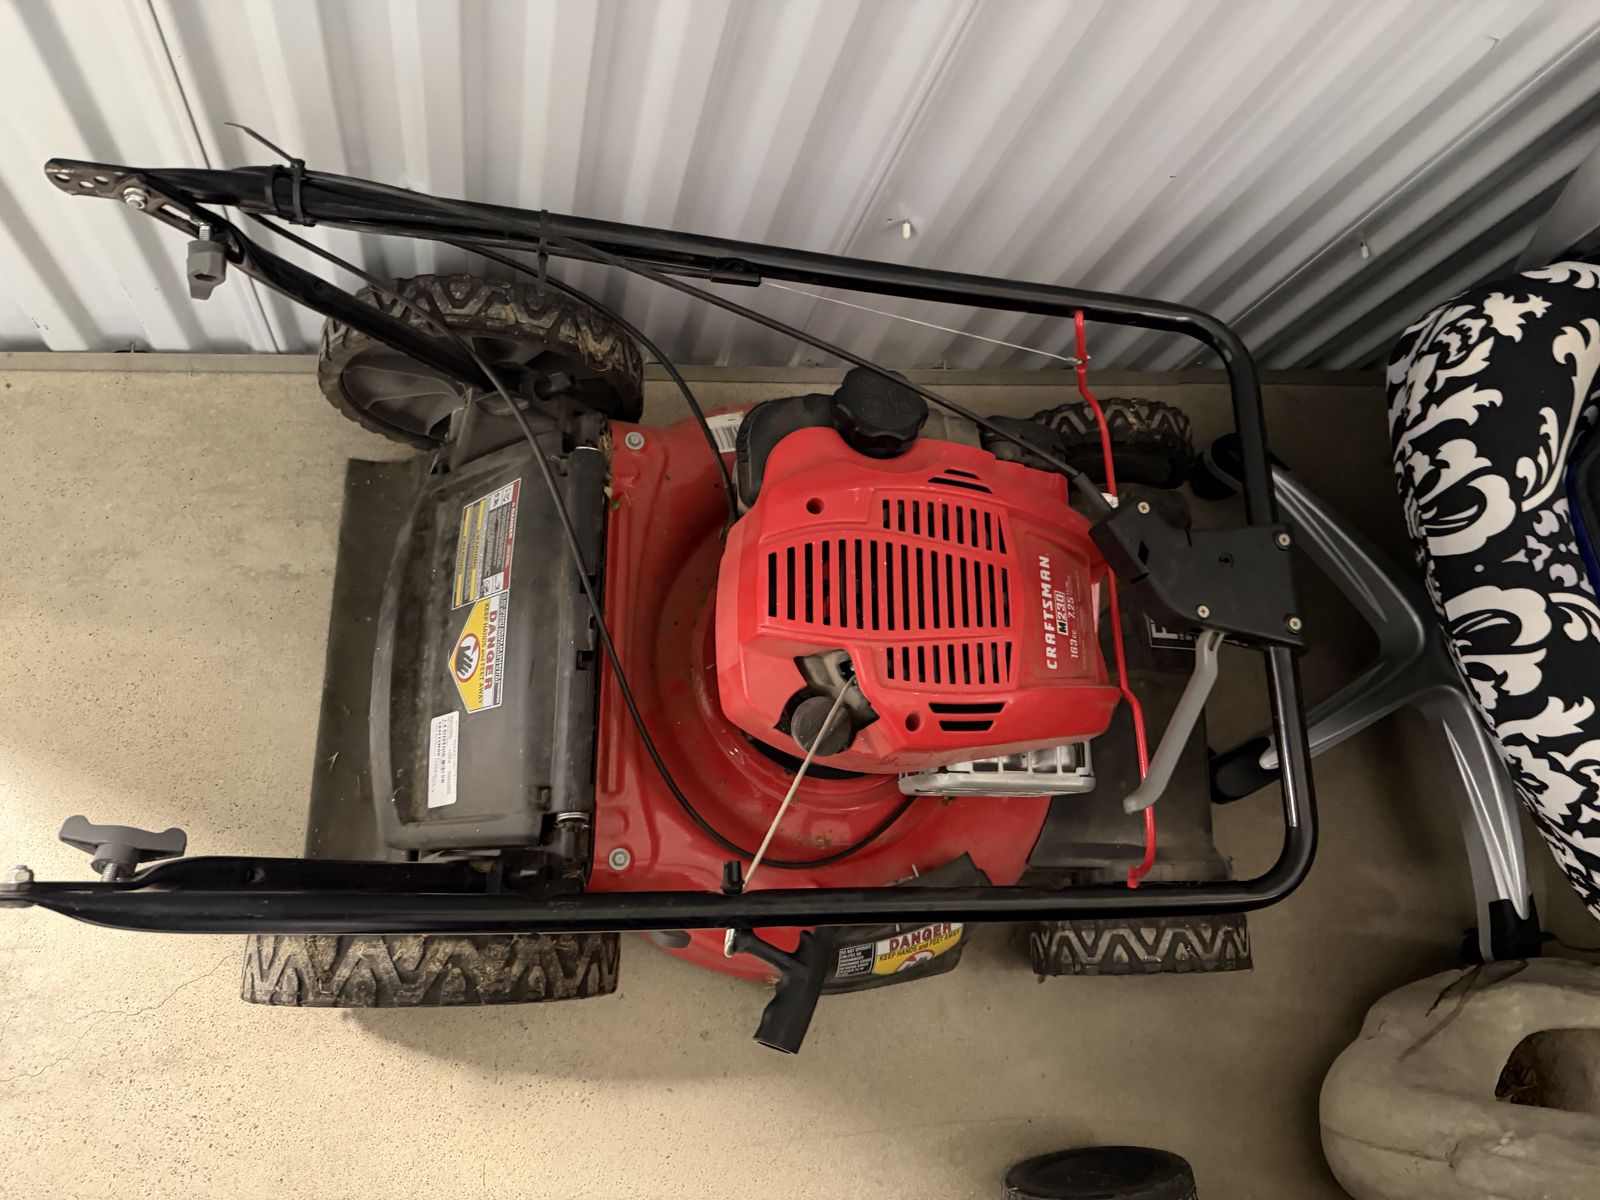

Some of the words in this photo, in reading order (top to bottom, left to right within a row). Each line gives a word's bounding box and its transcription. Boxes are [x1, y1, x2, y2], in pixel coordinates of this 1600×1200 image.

[1038, 555, 1058, 670] CRAFTSMAN
[1055, 591, 1068, 635] M230
[1067, 596, 1076, 619] 7.25
[484, 610, 498, 690] DANGER
[880, 951, 896, 961] KEEP
[897, 944, 917, 956] HANDS
[929, 936, 943, 946] FEET
[944, 928, 960, 940] AWAY
[889, 922, 952, 951] DANGER
